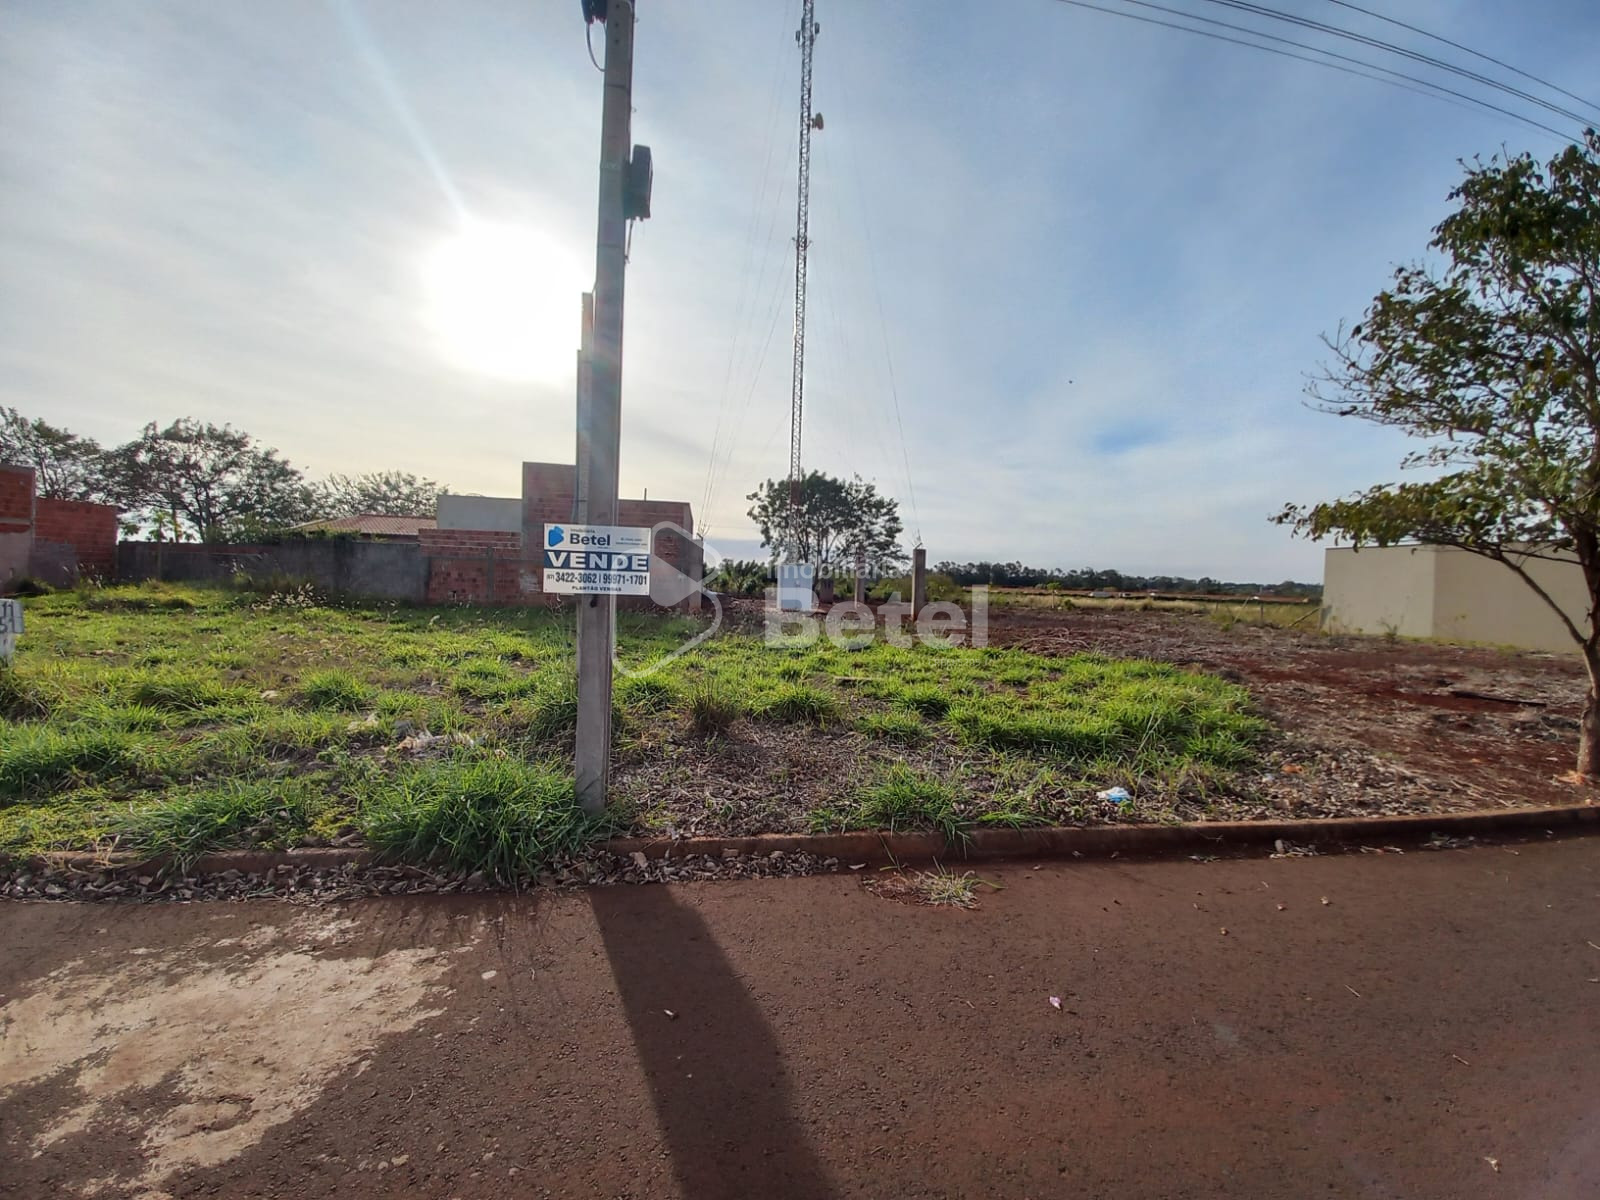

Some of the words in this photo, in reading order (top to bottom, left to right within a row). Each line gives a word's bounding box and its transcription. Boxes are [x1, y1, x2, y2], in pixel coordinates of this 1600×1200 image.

[570, 533, 611, 546] Betel
[547, 551, 648, 571] VENDE
[555, 572, 598, 583] 3422-3062
[602, 574, 647, 585] 99971-1701
